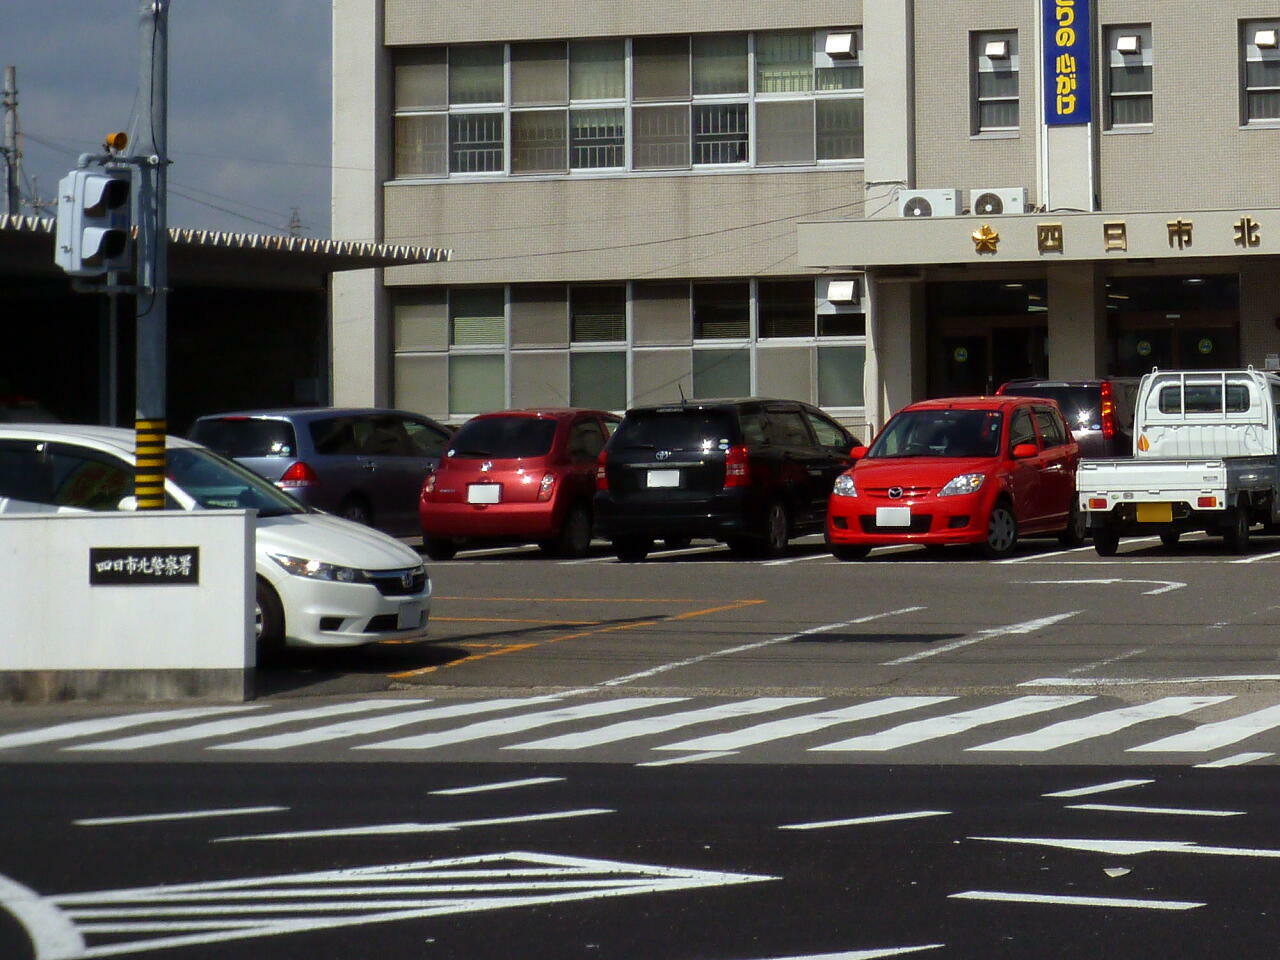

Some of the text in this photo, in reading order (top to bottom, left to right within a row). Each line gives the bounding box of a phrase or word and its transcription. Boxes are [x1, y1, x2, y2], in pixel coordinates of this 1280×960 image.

[1056, 53, 1077, 115] 心がけ
[95, 554, 192, 577] 四日市北警察署
